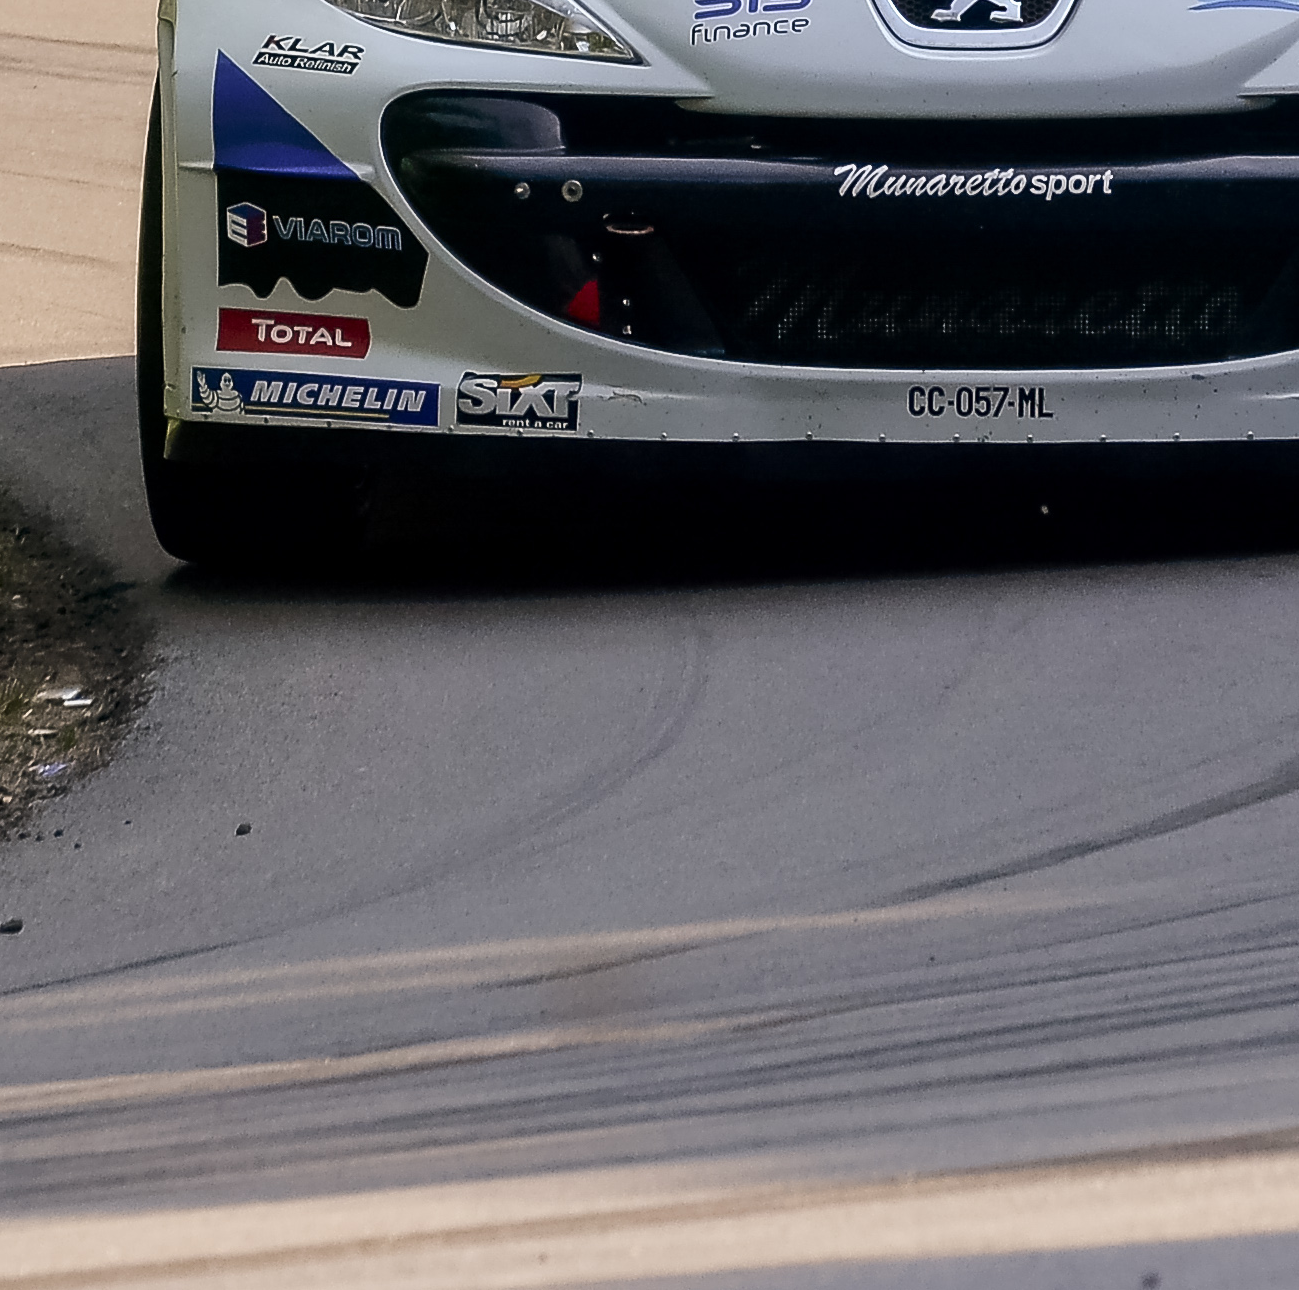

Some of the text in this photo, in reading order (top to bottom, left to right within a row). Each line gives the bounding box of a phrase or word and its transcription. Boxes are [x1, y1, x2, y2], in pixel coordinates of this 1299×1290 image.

[690, 18, 810, 46] finance
[257, 53, 352, 74] Auto Refinish
[261, 35, 365, 61] KLAR
[833, 164, 1114, 201] Munaretto sport
[272, 215, 403, 251] VIAROM
[250, 379, 427, 413] MICHELIN
[907, 385, 1055, 419] CC-057-ML
[502, 417, 531, 428] rent
[546, 421, 569, 430] car
